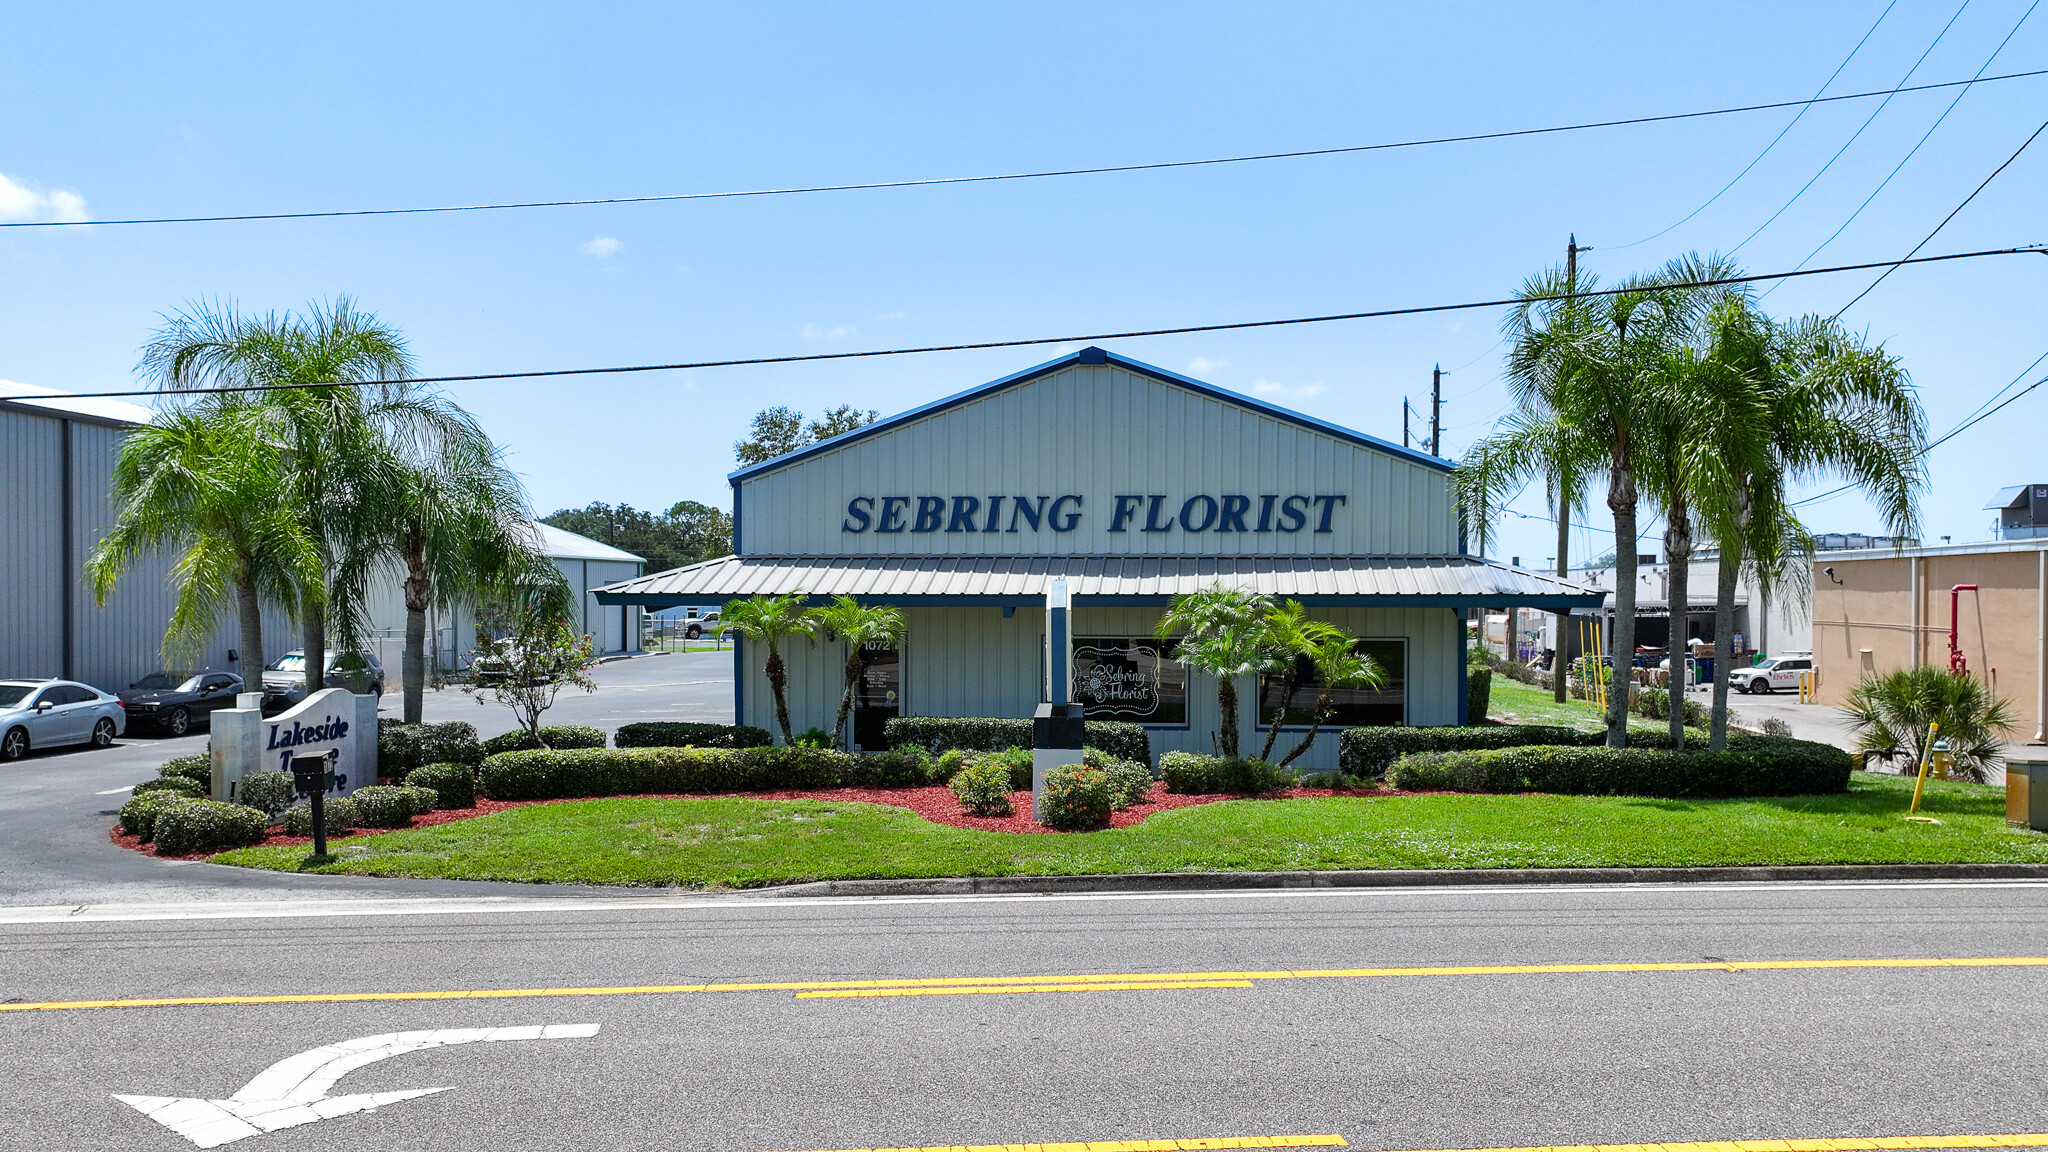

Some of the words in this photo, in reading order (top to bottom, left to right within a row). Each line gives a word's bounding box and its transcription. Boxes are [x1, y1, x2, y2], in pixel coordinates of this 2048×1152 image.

[842, 494, 1083, 534] SEBRING
[1107, 494, 1347, 534] FLORIST
[863, 640, 890, 650] 1072
[1105, 664, 1146, 687] Sebring
[1108, 681, 1150, 700] Florist
[266, 715, 349, 750] Lakeside
